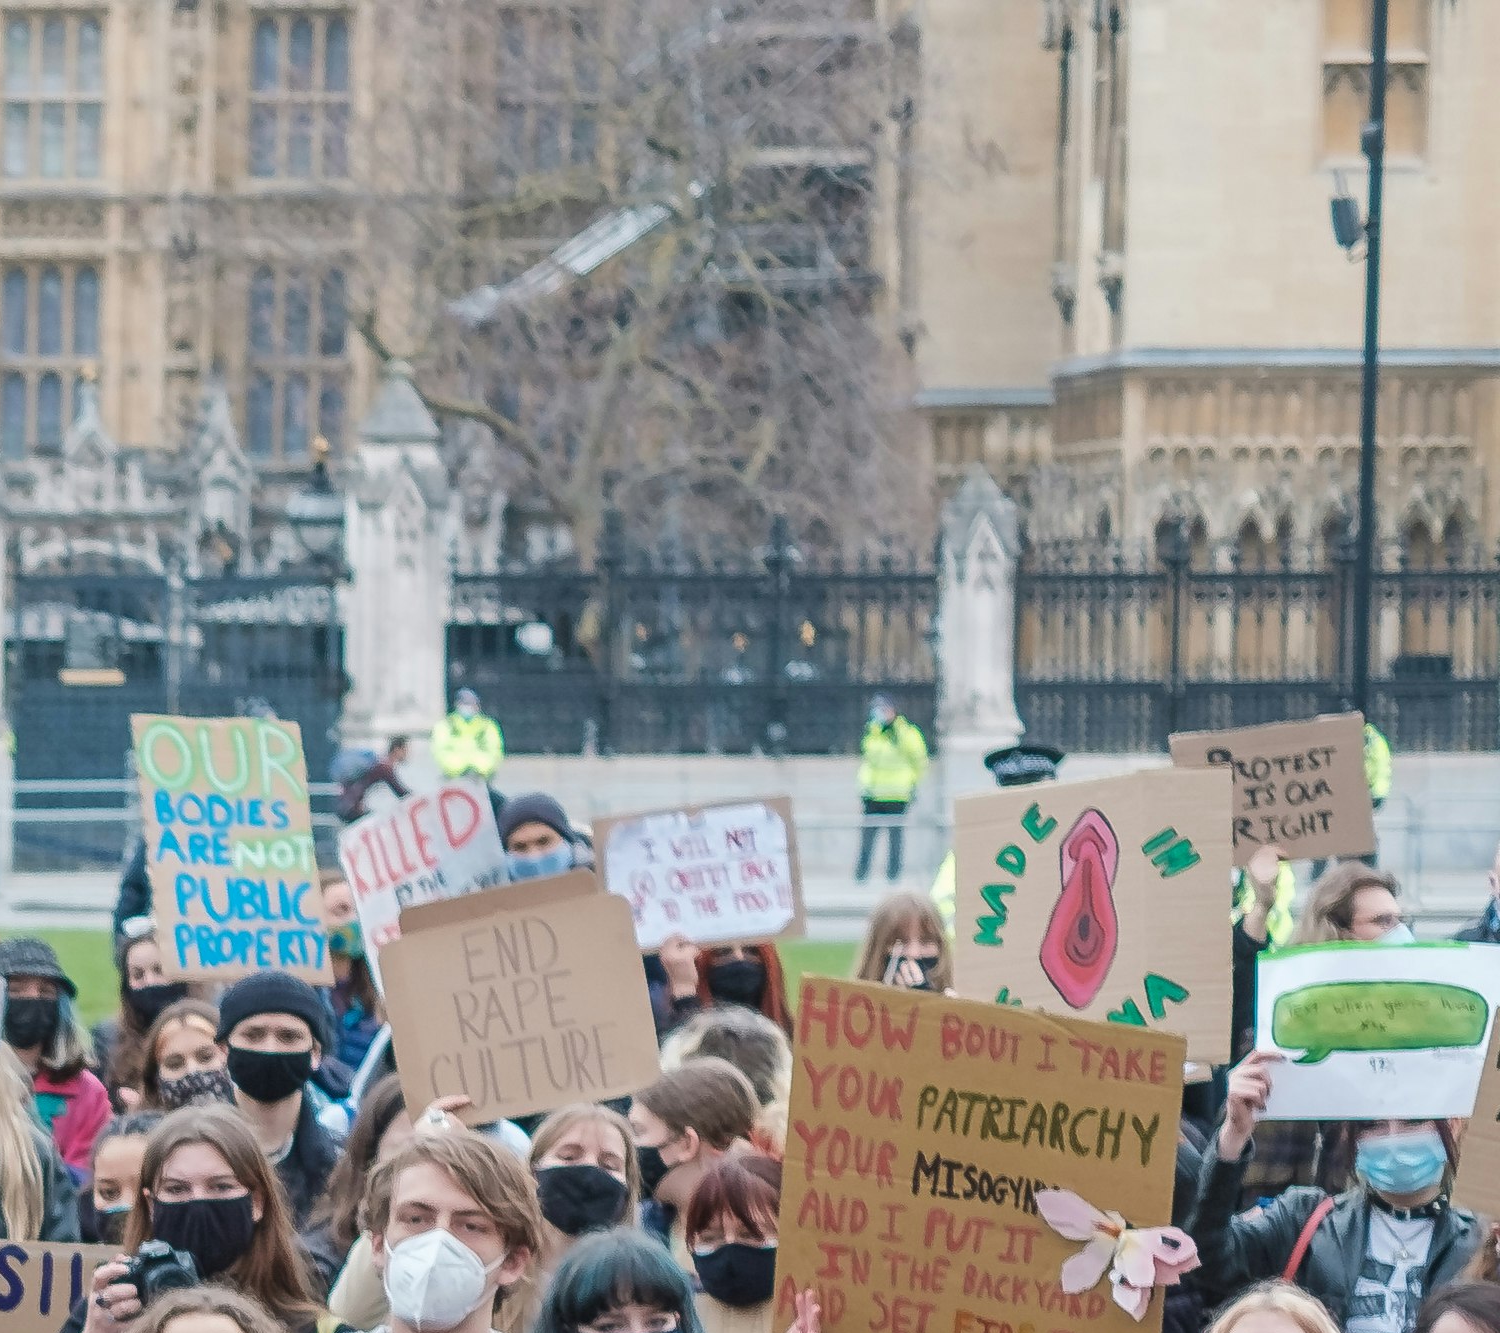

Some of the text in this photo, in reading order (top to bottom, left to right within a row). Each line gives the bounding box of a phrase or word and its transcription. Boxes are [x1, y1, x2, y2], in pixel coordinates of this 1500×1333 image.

[140, 718, 307, 801] OUR
[154, 788, 290, 830] BODIES
[1232, 811, 1334, 848] RIGHT
[1245, 785, 1275, 809] IS
[156, 827, 315, 873] ARE NOT
[344, 786, 483, 897] KILLED
[175, 873, 322, 925] PUBLIC
[175, 923, 326, 972] PROPERTY
[460, 915, 560, 985] END
[452, 968, 577, 1043] RAPE
[799, 984, 1169, 1085] HOW BOUT I TAKE
[429, 1021, 624, 1111] CULTURE
[801, 1057, 1161, 1169] YOUR PATRIARCHY
[793, 1121, 1060, 1217] YOUR MISOGYN
[797, 1187, 1043, 1265] AND I PUT IT
[817, 1241, 871, 1287] IN
[882, 1250, 950, 1296] THE
